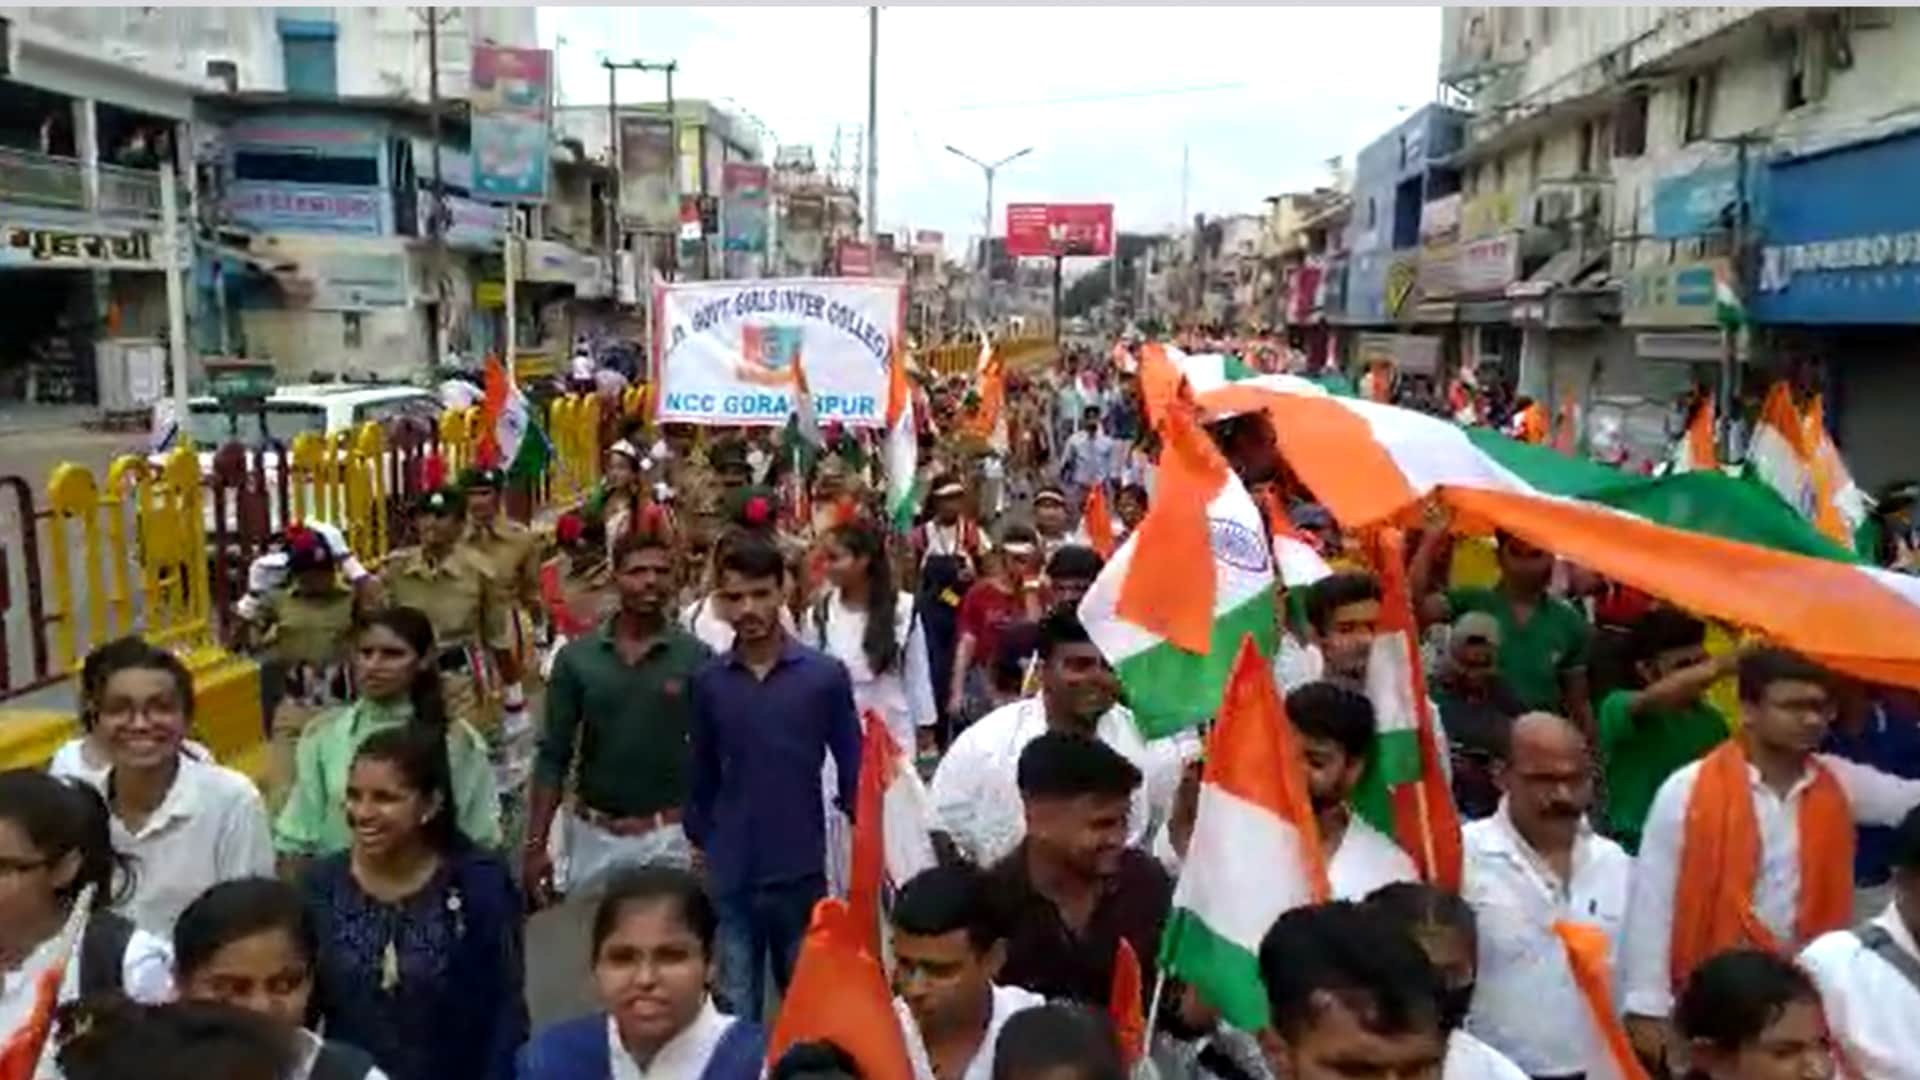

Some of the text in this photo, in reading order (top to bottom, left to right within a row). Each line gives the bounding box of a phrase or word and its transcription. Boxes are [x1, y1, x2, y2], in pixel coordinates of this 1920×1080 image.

[735, 288, 778, 316] GIRLS
[780, 289, 826, 321] INTER
[666, 393, 715, 412] NCC
